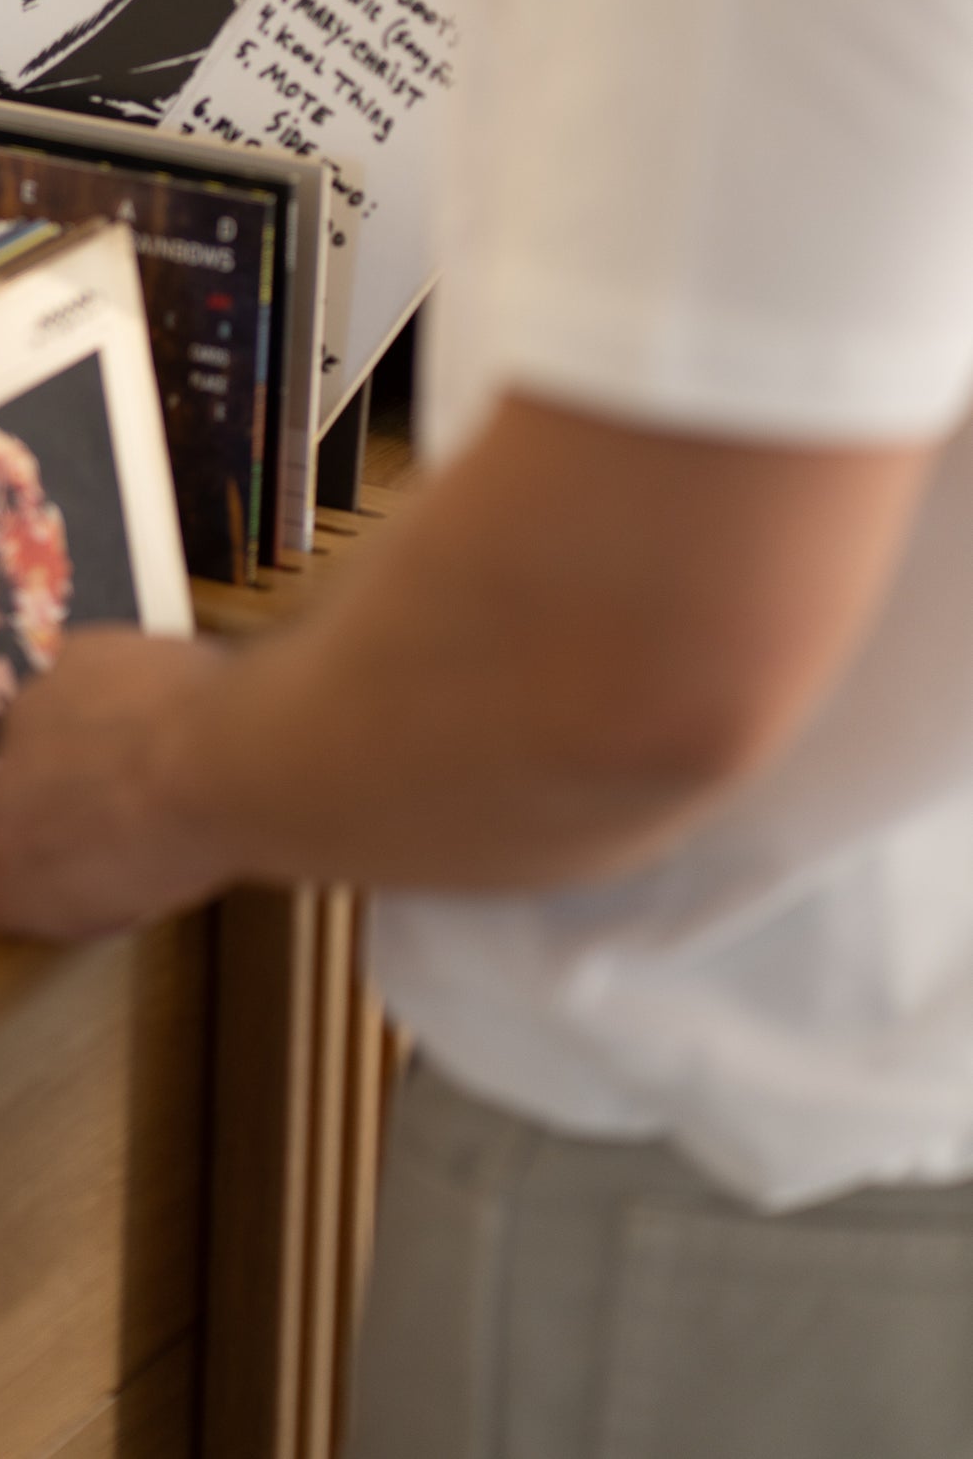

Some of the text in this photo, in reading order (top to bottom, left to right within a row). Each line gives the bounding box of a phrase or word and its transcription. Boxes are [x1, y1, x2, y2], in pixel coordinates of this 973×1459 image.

[193, 96, 212, 125] 6.
[234, 39, 335, 126] 5. MOTE
